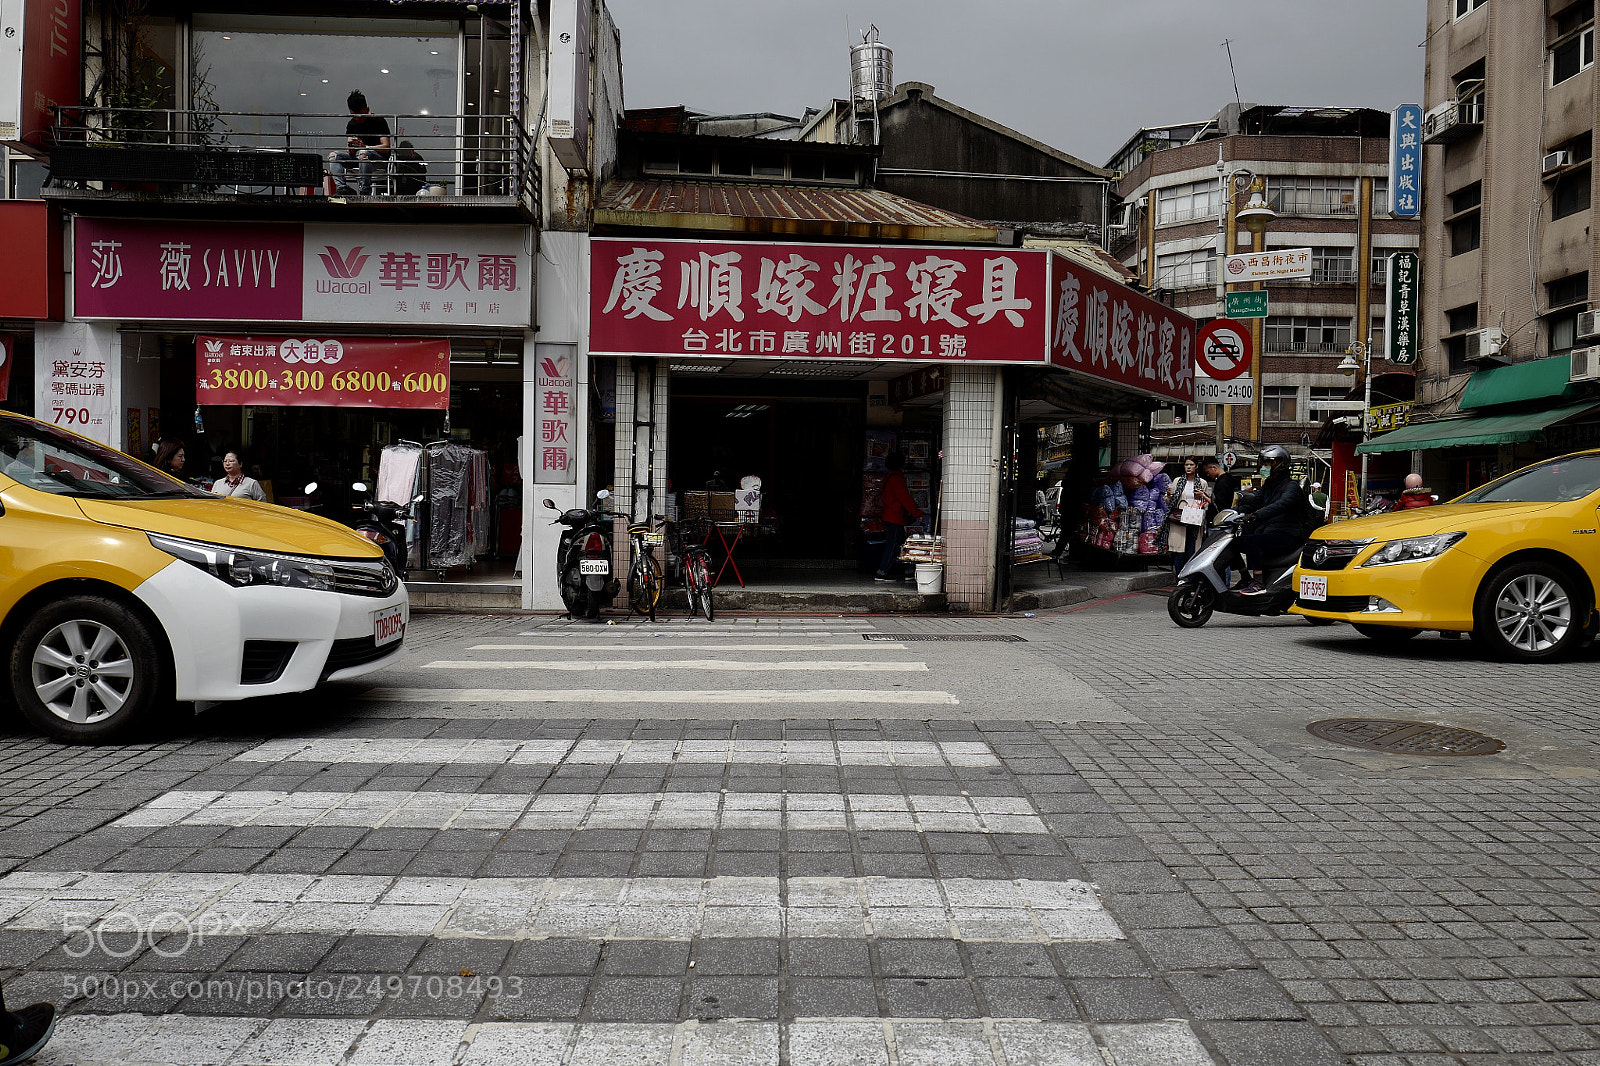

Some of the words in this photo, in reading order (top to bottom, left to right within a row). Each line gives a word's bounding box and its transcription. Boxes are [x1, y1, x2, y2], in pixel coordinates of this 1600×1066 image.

[90, 239, 192, 291] 莎薇
[203, 248, 280, 289] SAVVY
[1247, 252, 1309, 268] 西昌街夜市
[379, 252, 517, 292] 華歌爾
[316, 279, 371, 295] Wacoal
[395, 300, 501, 315] 美華專門店
[1396, 255, 1412, 363] 福記青草漢藥房
[229, 343, 277, 357] 結束出清
[283, 342, 340, 360] 大拍賣
[681, 327, 967, 358] 台北市廣州街201號
[51, 360, 106, 379] 黛安芬
[51, 381, 106, 397] 零碼出清
[538, 377, 573, 388] Wacoal
[52, 407, 90, 425] 790
[542, 390, 569, 471] 華歌爾
